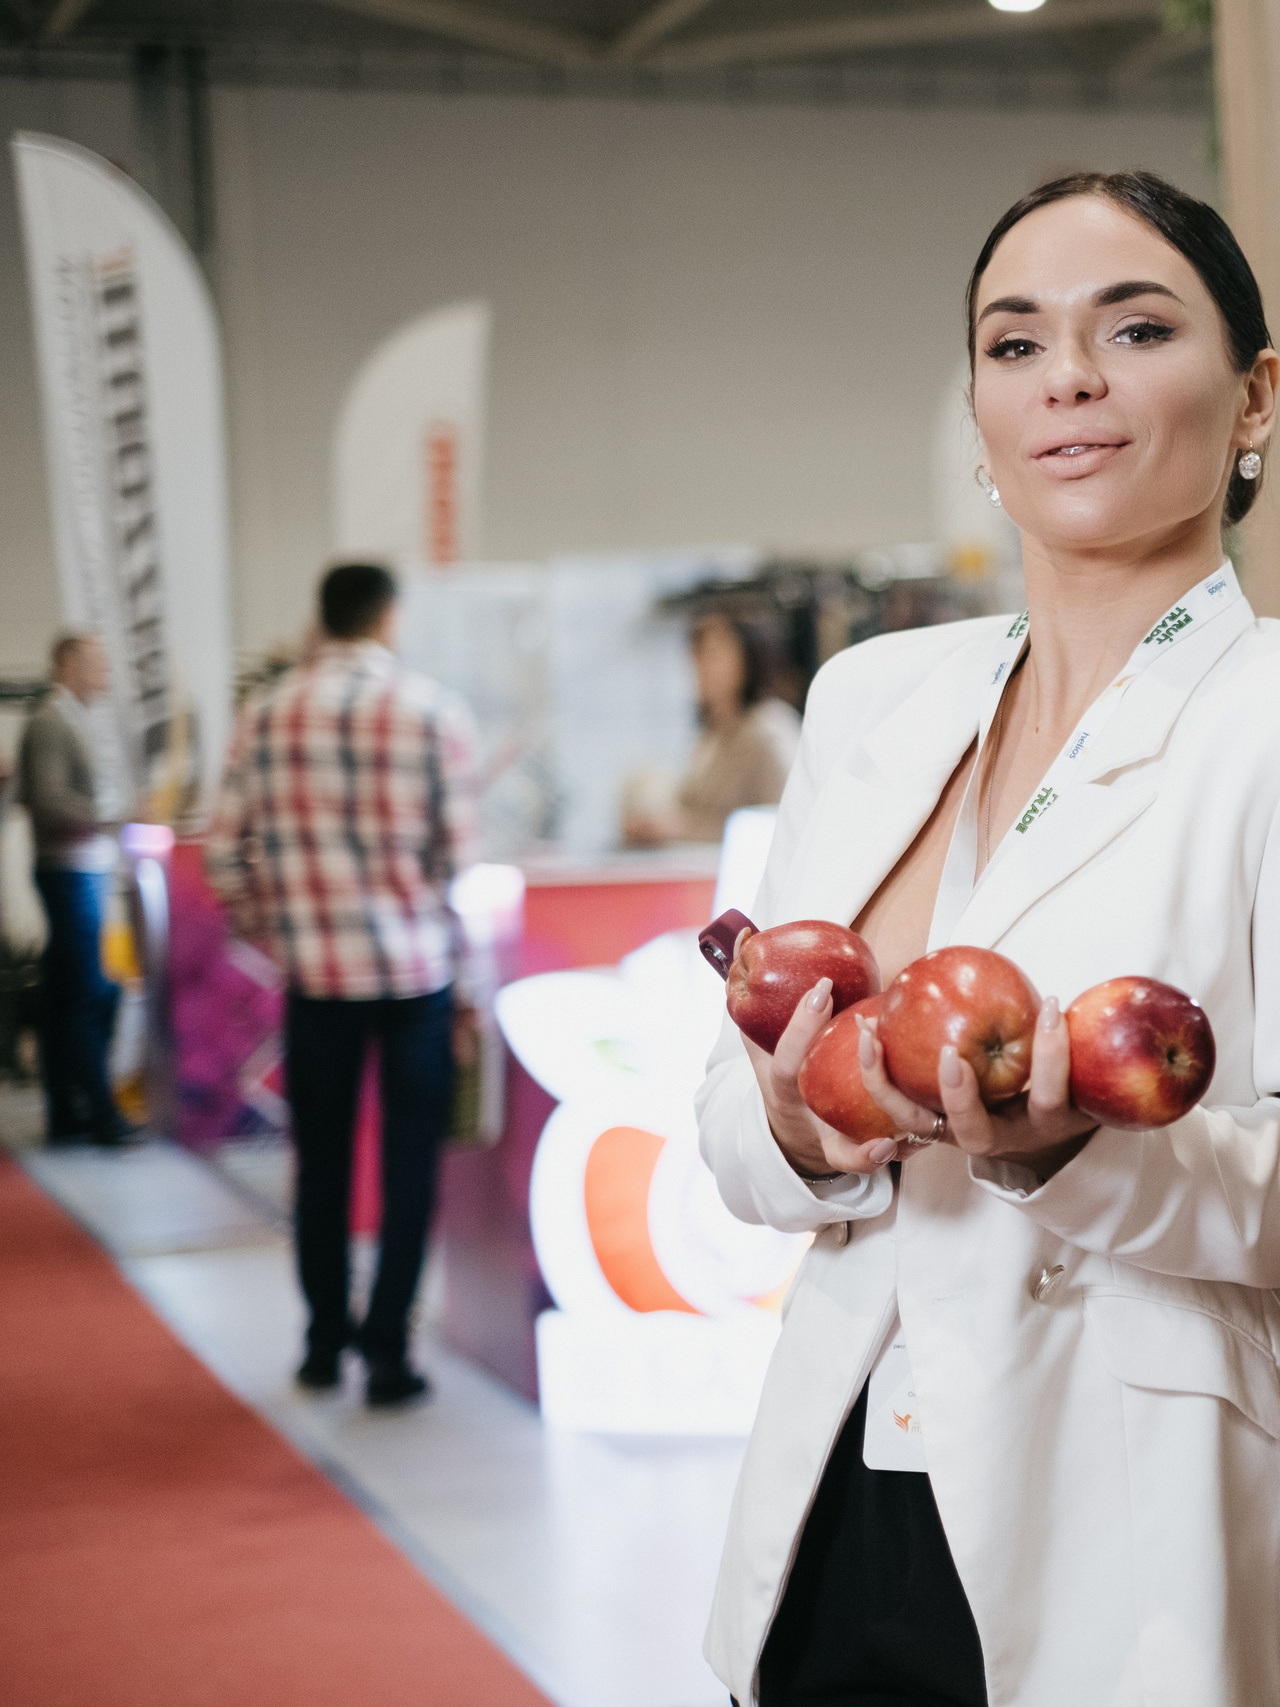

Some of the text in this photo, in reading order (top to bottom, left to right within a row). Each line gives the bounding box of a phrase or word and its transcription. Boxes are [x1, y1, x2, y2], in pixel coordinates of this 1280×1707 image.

[1143, 607, 1187, 645] TRADE
[1069, 732, 1091, 760] helios
[1015, 787, 1054, 834] TRADE
